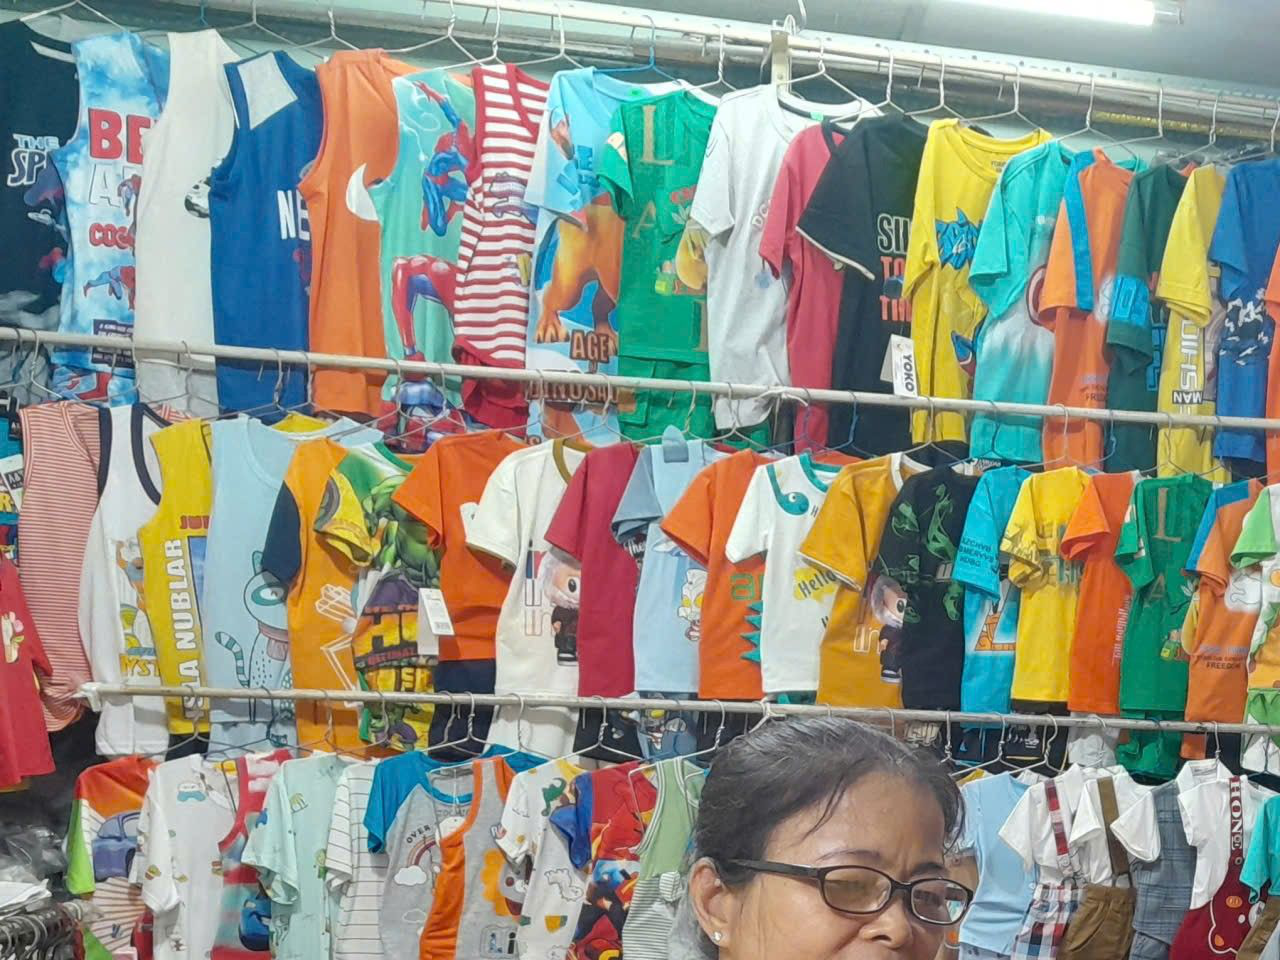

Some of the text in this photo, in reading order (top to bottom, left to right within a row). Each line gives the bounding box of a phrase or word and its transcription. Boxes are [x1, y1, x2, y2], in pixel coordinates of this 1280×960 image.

[571, 331, 609, 362] AGE
[902, 353, 916, 393] YOKO
[164, 538, 197, 650] NUBLAR
[406, 824, 431, 844] OVER
